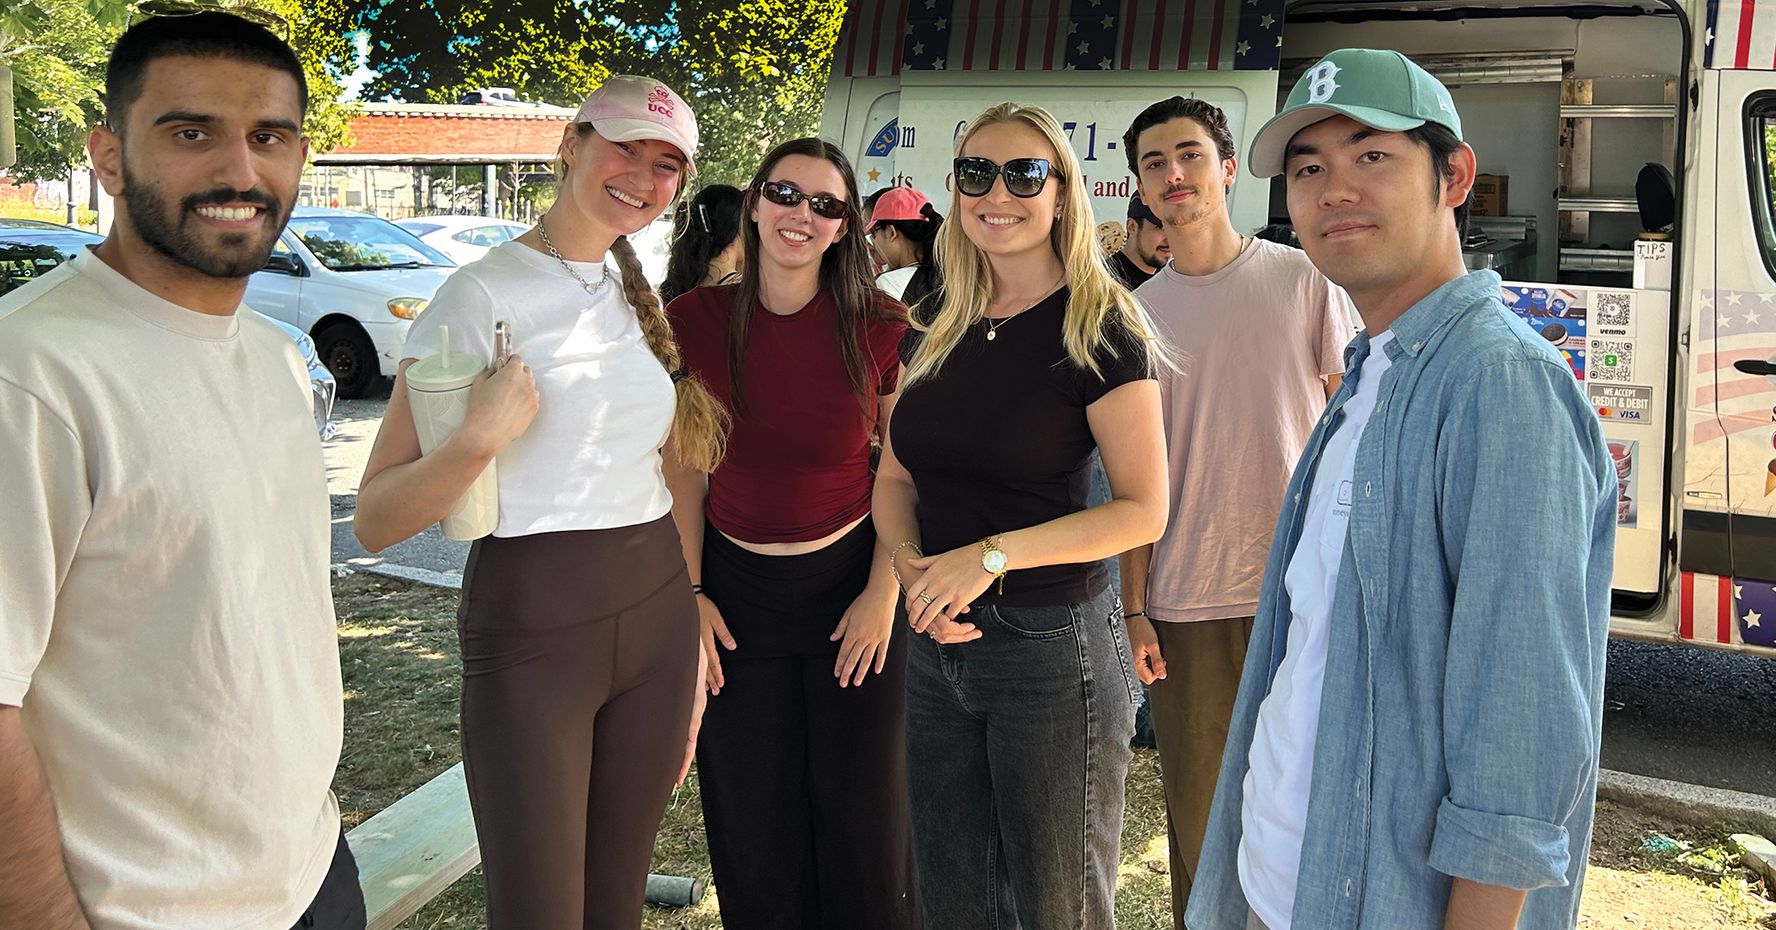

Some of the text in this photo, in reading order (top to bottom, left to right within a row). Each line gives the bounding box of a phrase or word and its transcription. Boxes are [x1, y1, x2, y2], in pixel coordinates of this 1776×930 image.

[1306, 61, 1342, 104] B
[648, 104, 672, 118] UCC
[1093, 176, 1131, 198] and
[1637, 243, 1665, 254] TIPS
[1600, 328, 1626, 336] venmo
[1604, 388, 1636, 397] WE ACCEPT
[1591, 396, 1648, 409] CREDIT & DEBIT
[1620, 410, 1641, 420] VISA
